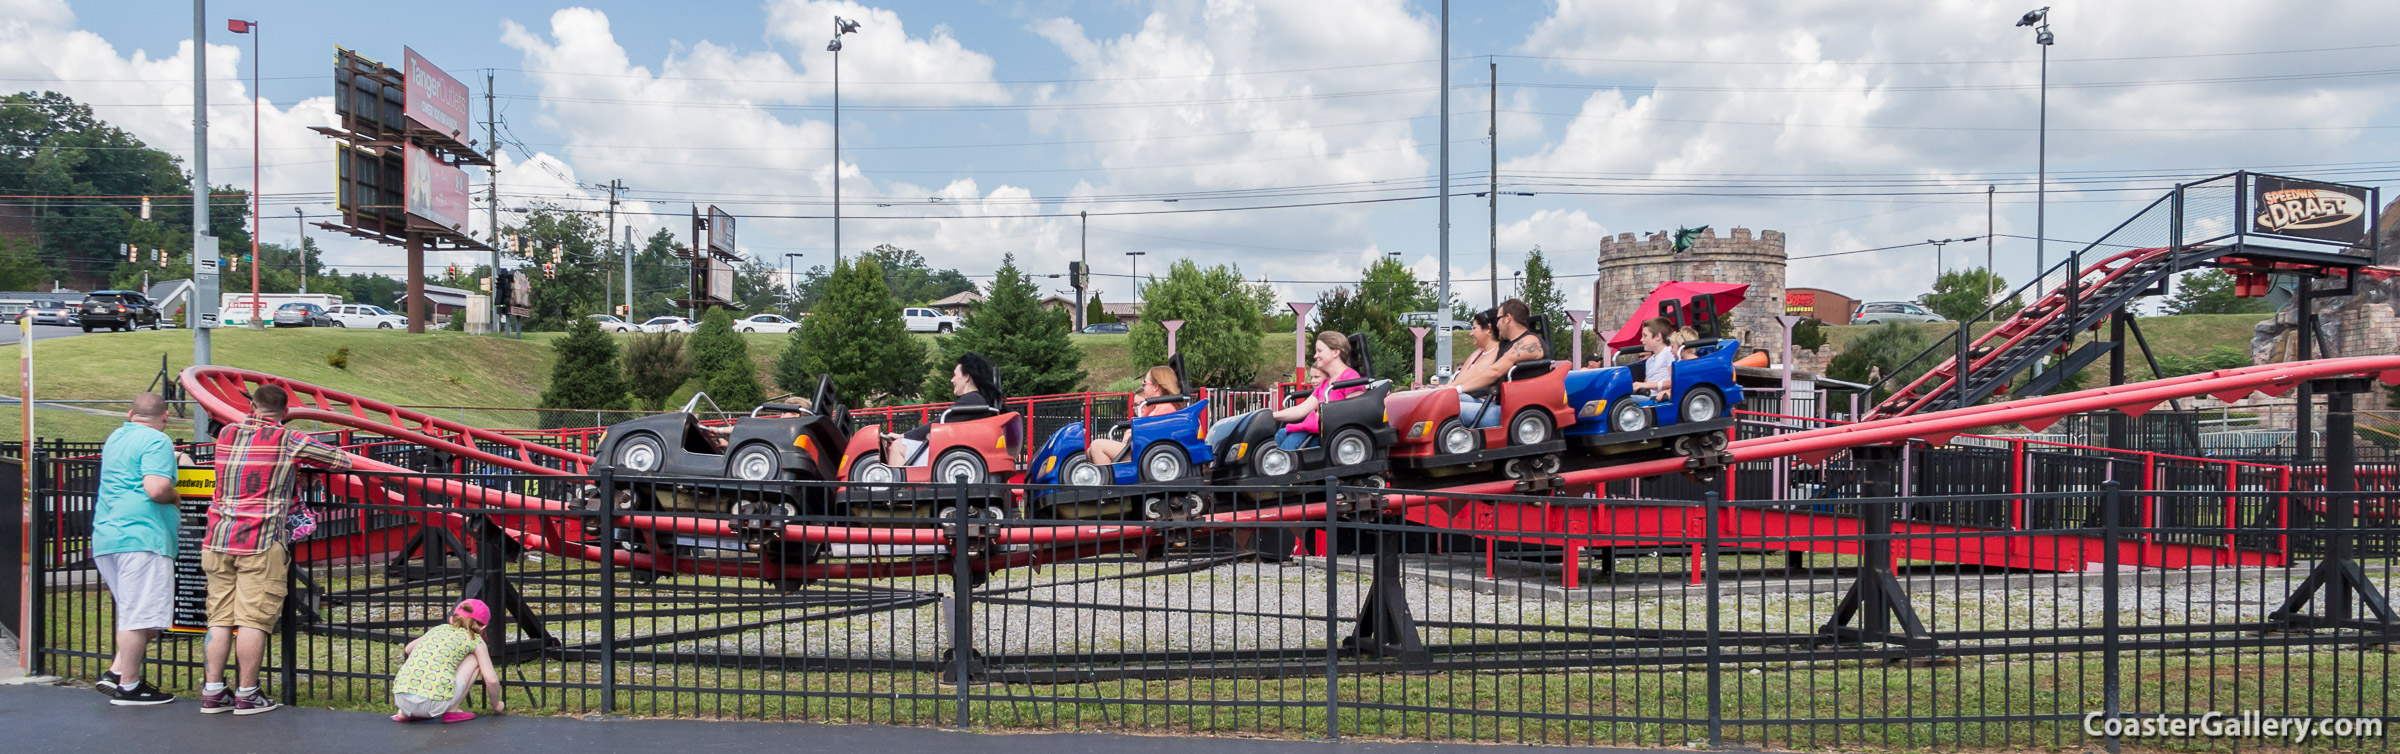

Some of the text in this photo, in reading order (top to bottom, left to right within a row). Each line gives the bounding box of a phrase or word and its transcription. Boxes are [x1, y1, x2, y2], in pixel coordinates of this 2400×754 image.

[2265, 189, 2319, 205] SPEEDWAY
[2269, 198, 2346, 228] DRAFT
[204, 478, 216, 488] Dra
